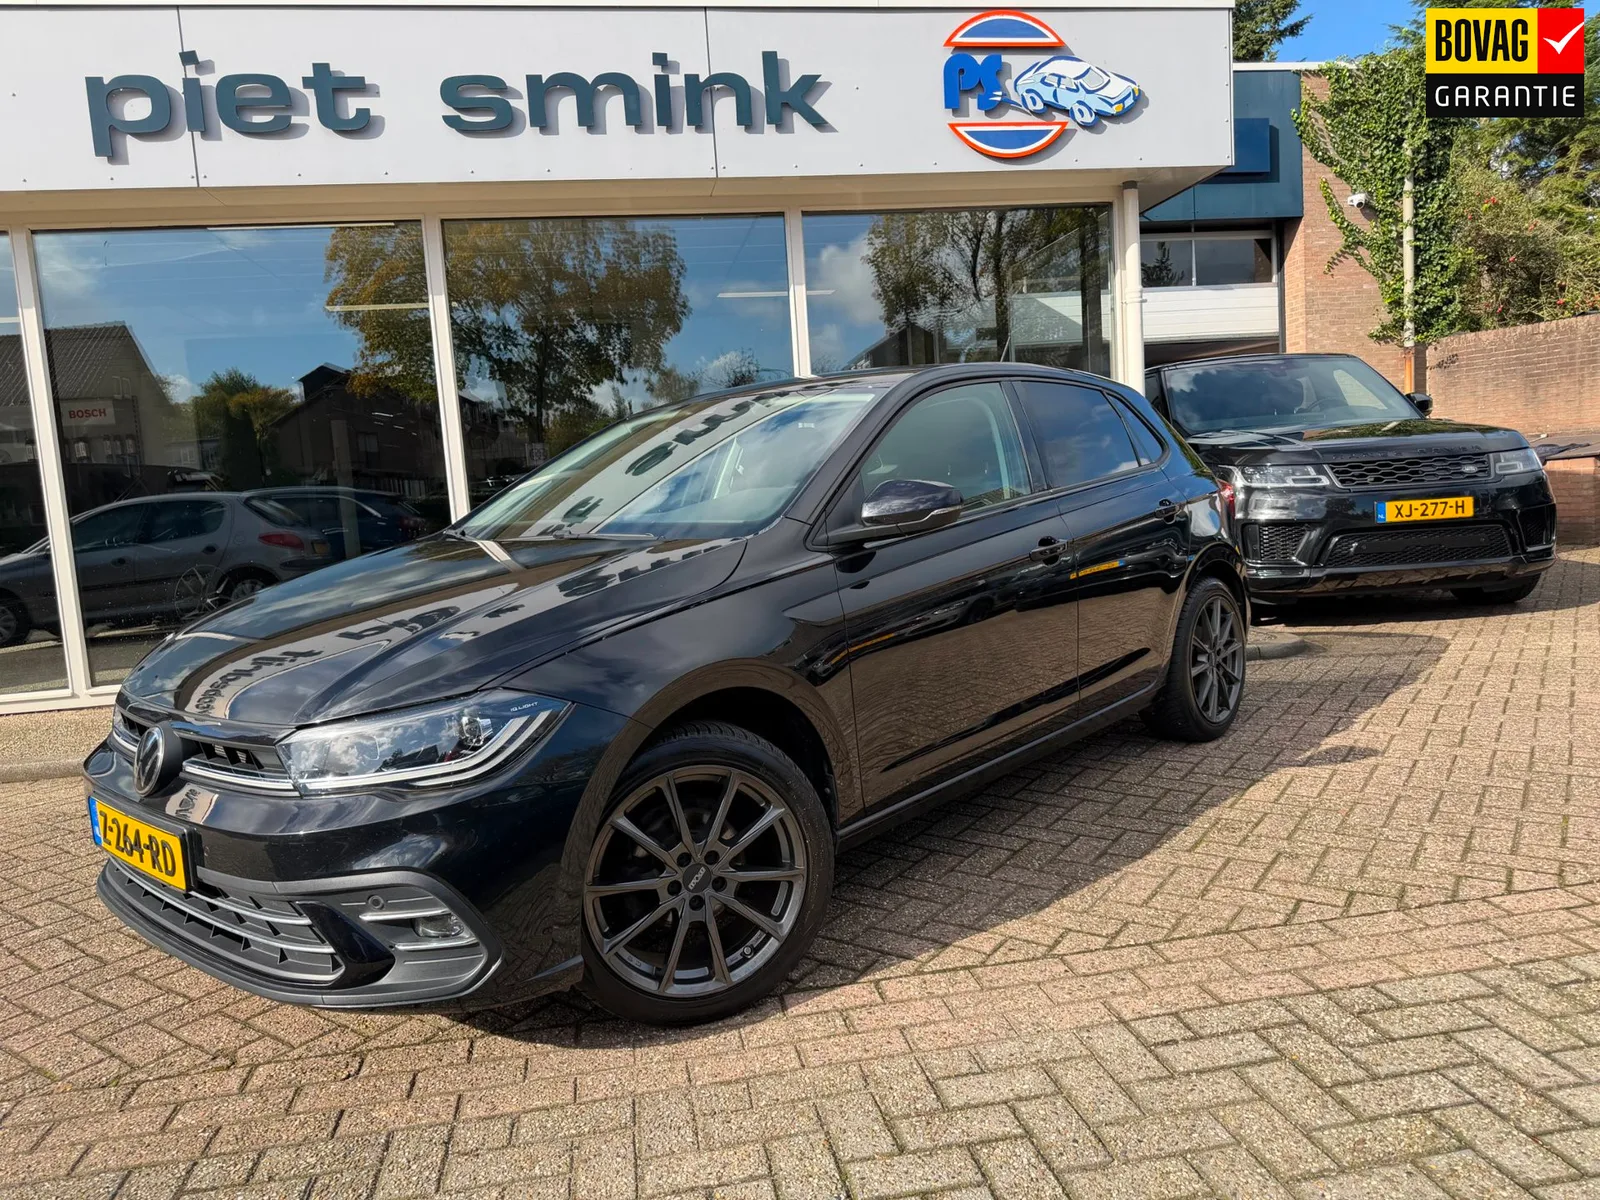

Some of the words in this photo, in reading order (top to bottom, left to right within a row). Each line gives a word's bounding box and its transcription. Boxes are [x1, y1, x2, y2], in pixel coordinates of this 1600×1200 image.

[85, 50, 371, 157] piet
[440, 51, 829, 131] smink
[69, 408, 107, 419] BOSCH
[1394, 500, 1465, 519] XJ-277-H
[99, 811, 177, 877] Z-264-RD
